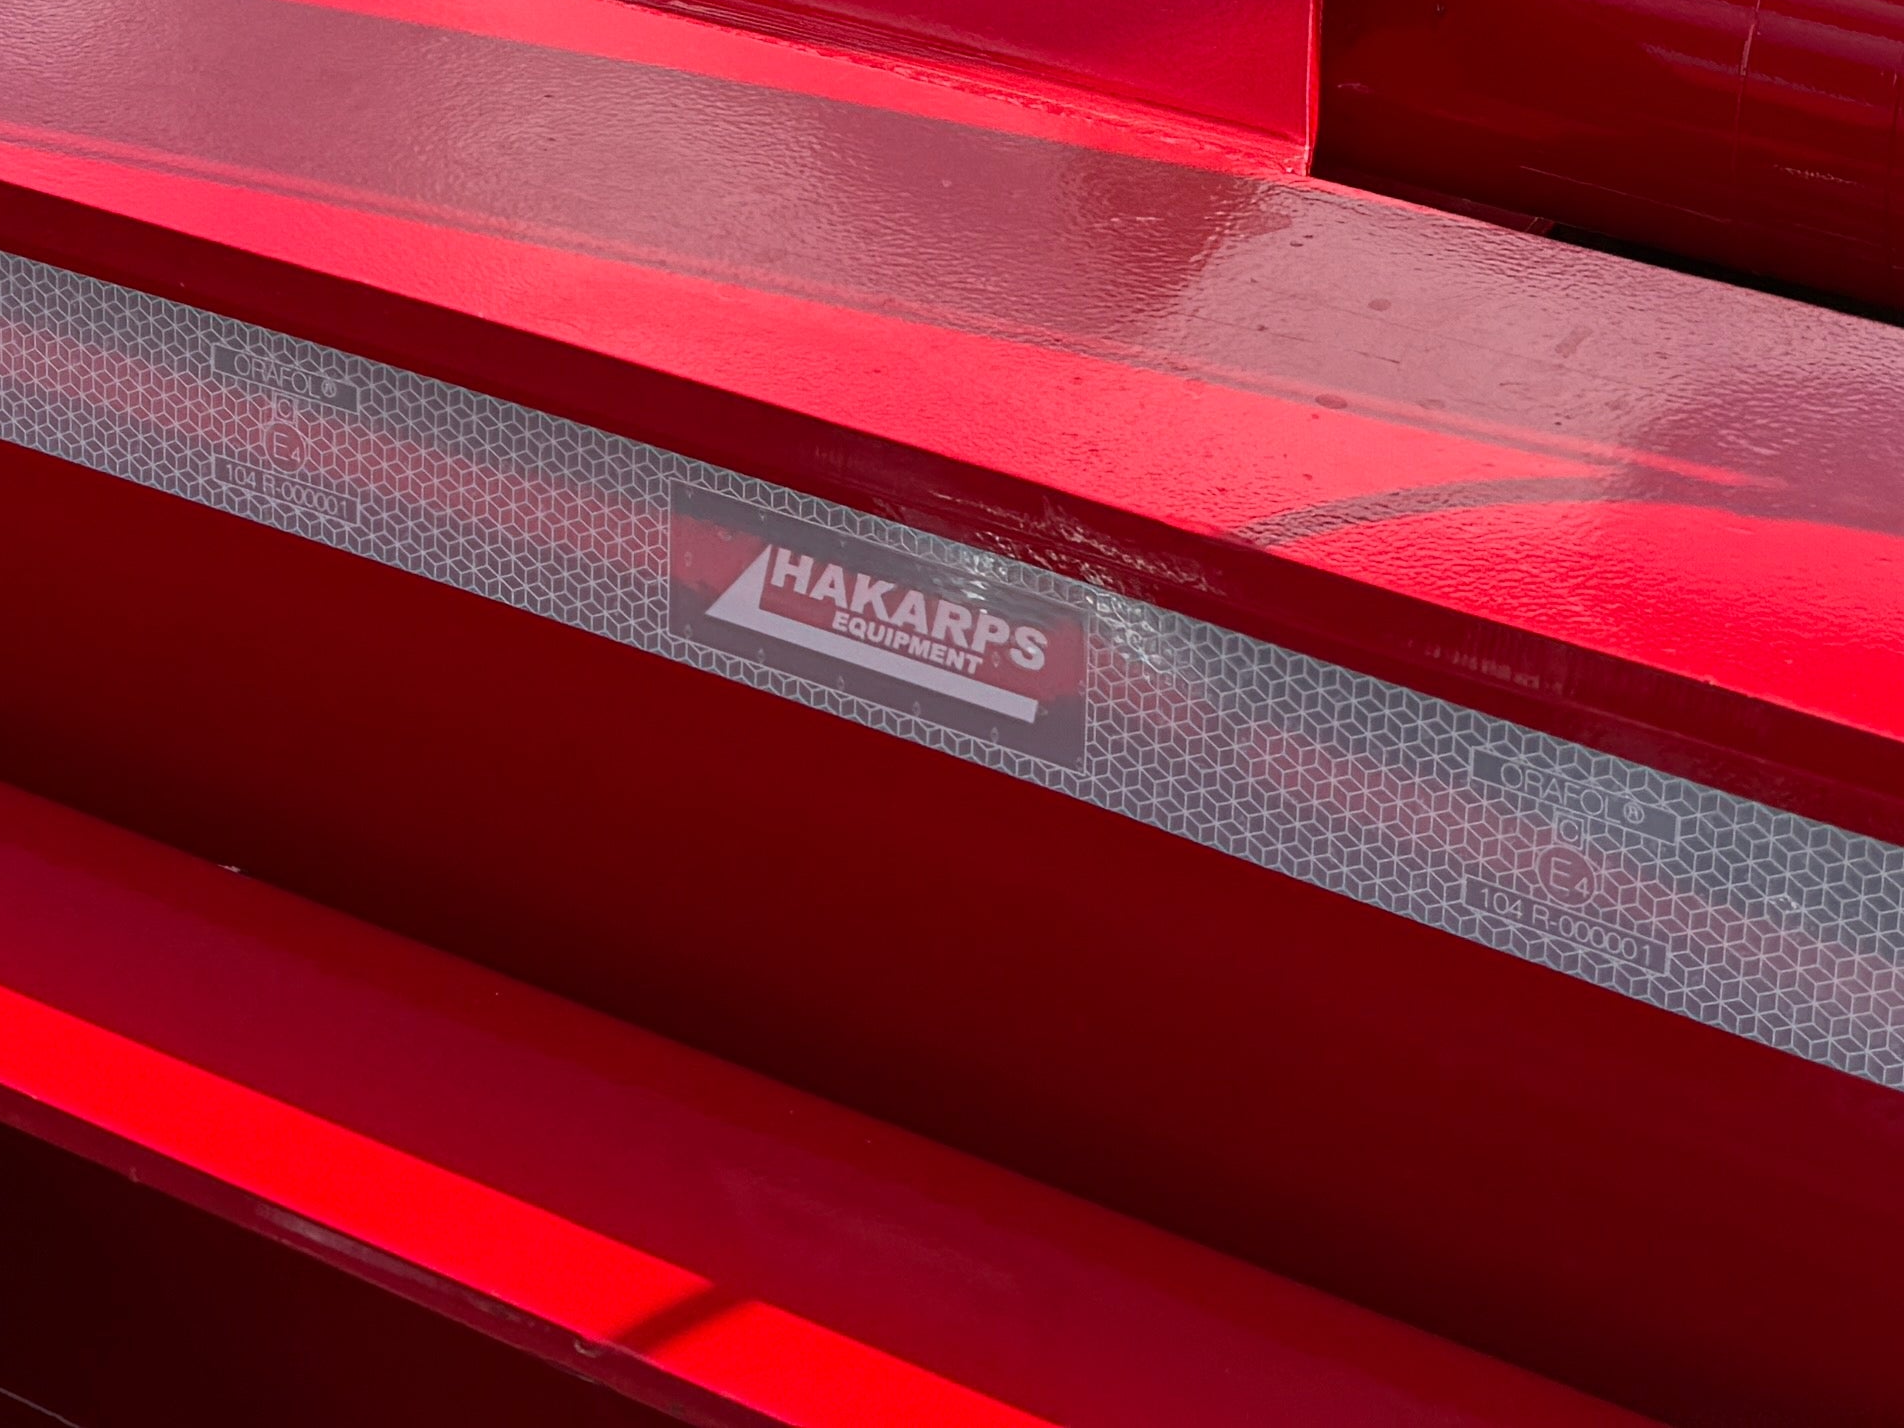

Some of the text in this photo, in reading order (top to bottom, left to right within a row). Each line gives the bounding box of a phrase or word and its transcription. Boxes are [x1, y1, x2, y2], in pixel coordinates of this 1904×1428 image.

[226, 463, 257, 489] 104
[768, 548, 1049, 672] HAKARPS
[831, 612, 984, 675] EQUIPMENT
[1480, 887, 1652, 966] 104 R-000001
